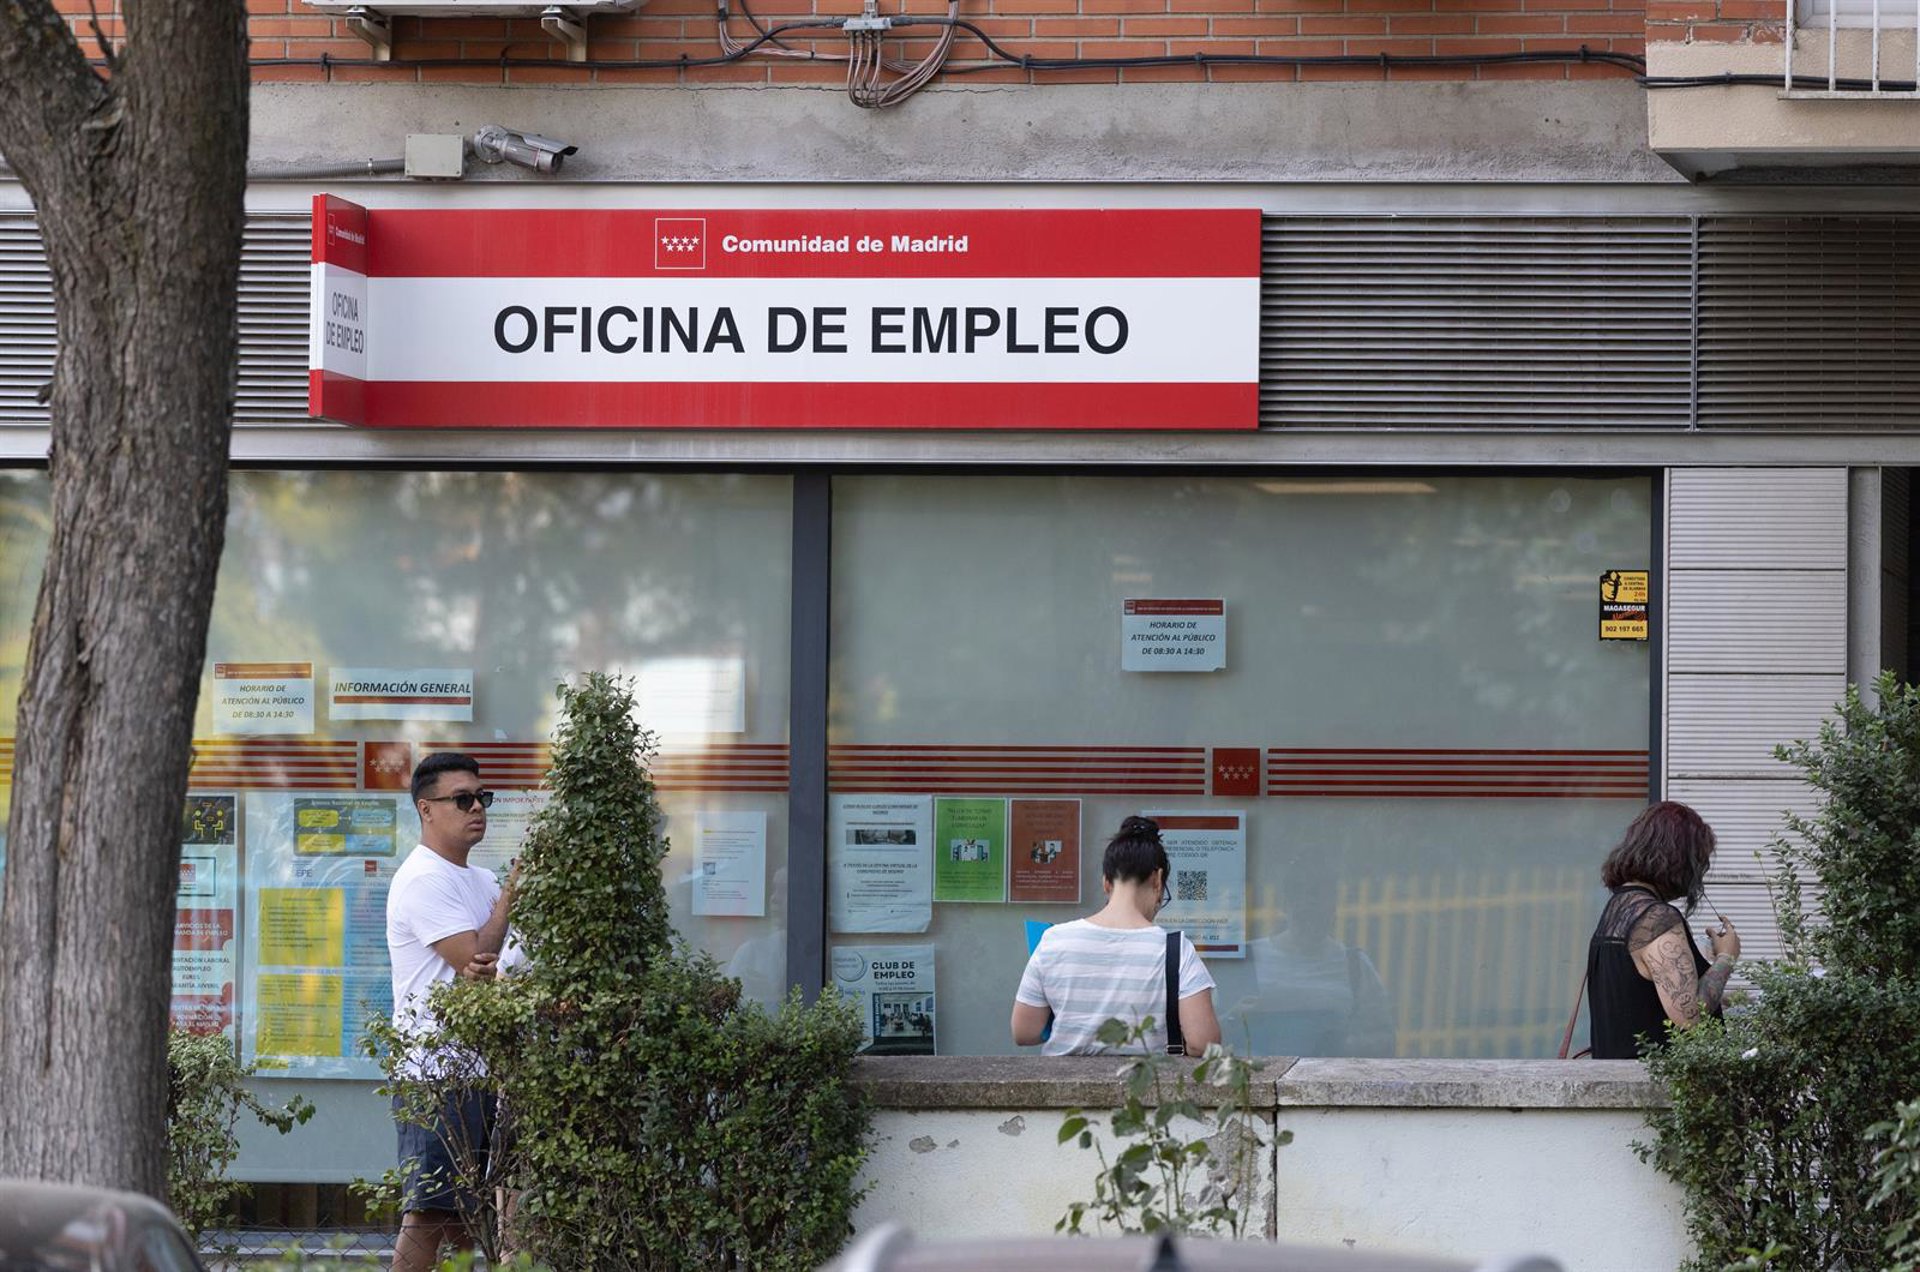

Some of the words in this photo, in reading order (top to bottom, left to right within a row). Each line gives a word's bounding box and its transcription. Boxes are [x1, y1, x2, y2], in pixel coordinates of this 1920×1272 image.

[722, 235, 848, 253] Comunidad
[857, 235, 884, 253] de
[891, 235, 968, 253] Madrid
[332, 292, 359, 322] OFICINA
[494, 305, 746, 355] OFICINA
[767, 306, 848, 354] DE
[871, 305, 1129, 355] EMPLEO
[326, 321, 335, 346] DE
[336, 325, 364, 354] EMPLEO
[1149, 621, 1185, 629] HORARIO
[1186, 621, 1197, 629] DE
[1131, 633, 1170, 642] ATENCIÓN
[1172, 634, 1182, 642] AL
[1183, 633, 1216, 642] PÚBLICO
[239, 685, 274, 693] HORARIO
[276, 685, 286, 693] DE
[334, 681, 418, 693] INFORMACIÓN
[419, 682, 471, 694] GENERAL
[221, 695, 260, 705] ATENCIÓN
[261, 697, 271, 705] AL
[272, 695, 305, 705] PÚBLICO
[232, 711, 242, 719] DE
[244, 711, 264, 719] 08:30
[266, 711, 272, 719] A
[273, 711, 294, 719] 14:30
[871, 961, 899, 970] CLUB
[901, 961, 916, 969] DE
[874, 971, 916, 979] EMPLEO
